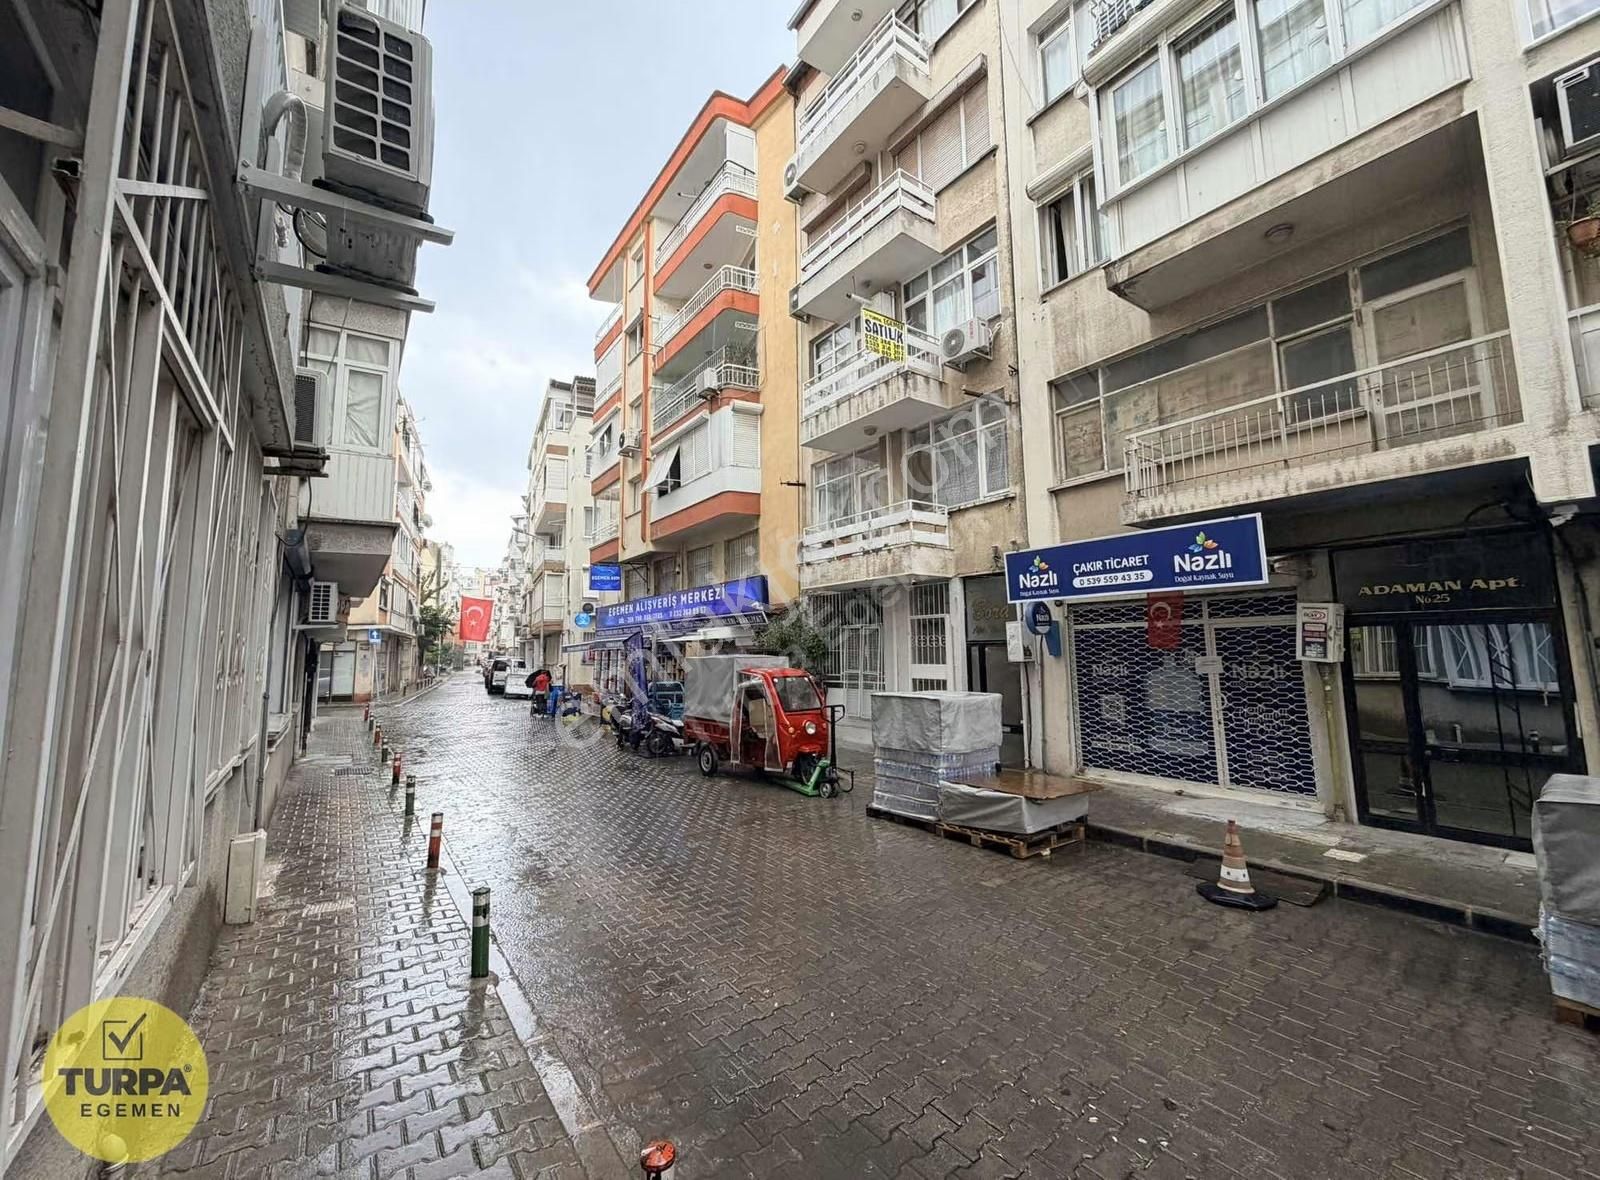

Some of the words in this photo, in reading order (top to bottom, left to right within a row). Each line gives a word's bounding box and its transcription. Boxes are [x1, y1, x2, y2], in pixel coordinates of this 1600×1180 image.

[865, 319, 903, 344] SATILIK
[1072, 560, 1103, 576] ÇAKIR
[1104, 554, 1149, 570] TİCARET
[1173, 550, 1232, 573] Nazlı
[1019, 570, 1058, 589] Nazlı
[1086, 577, 1101, 585] 539
[1103, 575, 1119, 583] 559
[1134, 572, 1145, 580] 35
[1358, 579, 1462, 596] ADAMAN
[608, 603, 634, 617] EGEMEN
[635, 595, 677, 612] ALIŞVERİŞ
[680, 583, 726, 605] MERKEZİ
